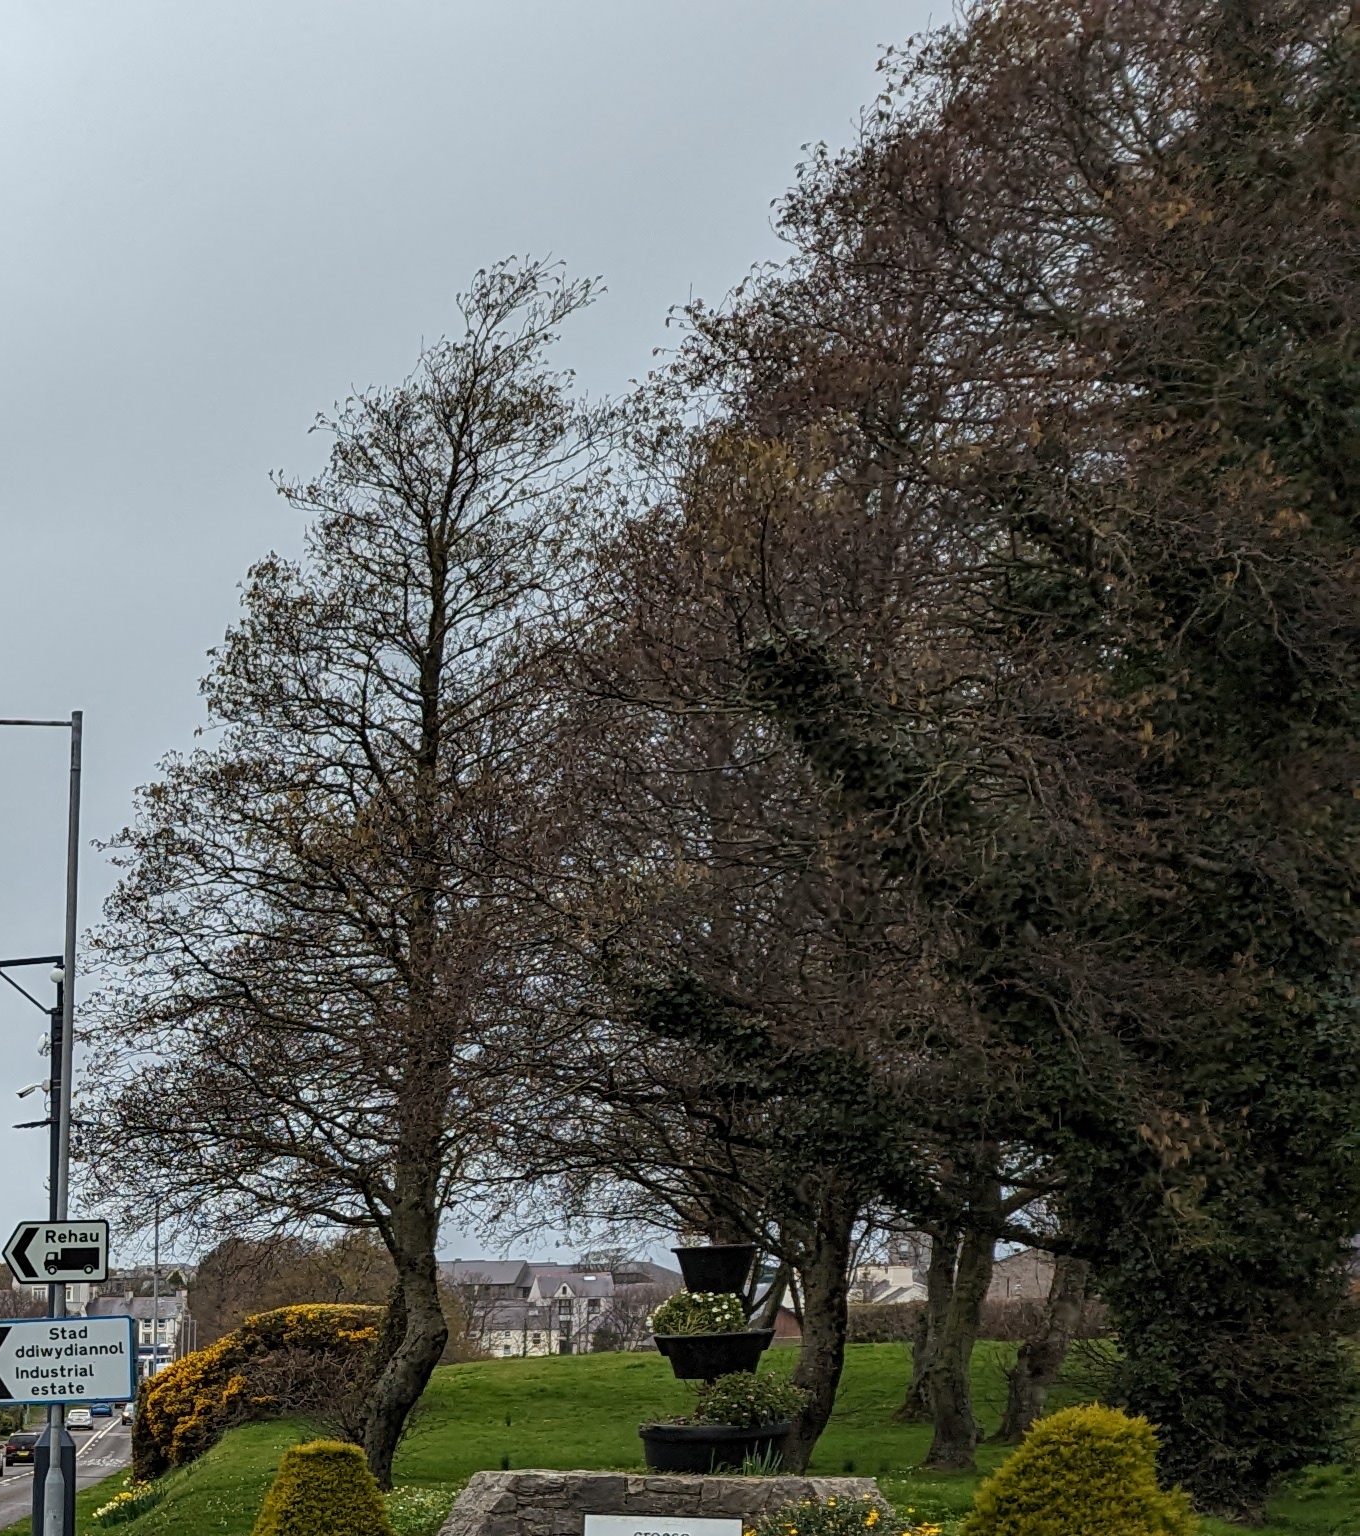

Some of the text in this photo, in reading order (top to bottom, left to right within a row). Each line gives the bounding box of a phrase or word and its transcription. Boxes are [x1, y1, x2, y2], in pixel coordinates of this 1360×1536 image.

[45, 1229, 100, 1243] Rehau
[49, 1325, 88, 1340] Stad
[15, 1341, 125, 1359] ddiwydiannol
[15, 1363, 95, 1379] Industrial
[31, 1382, 85, 1396] estate
